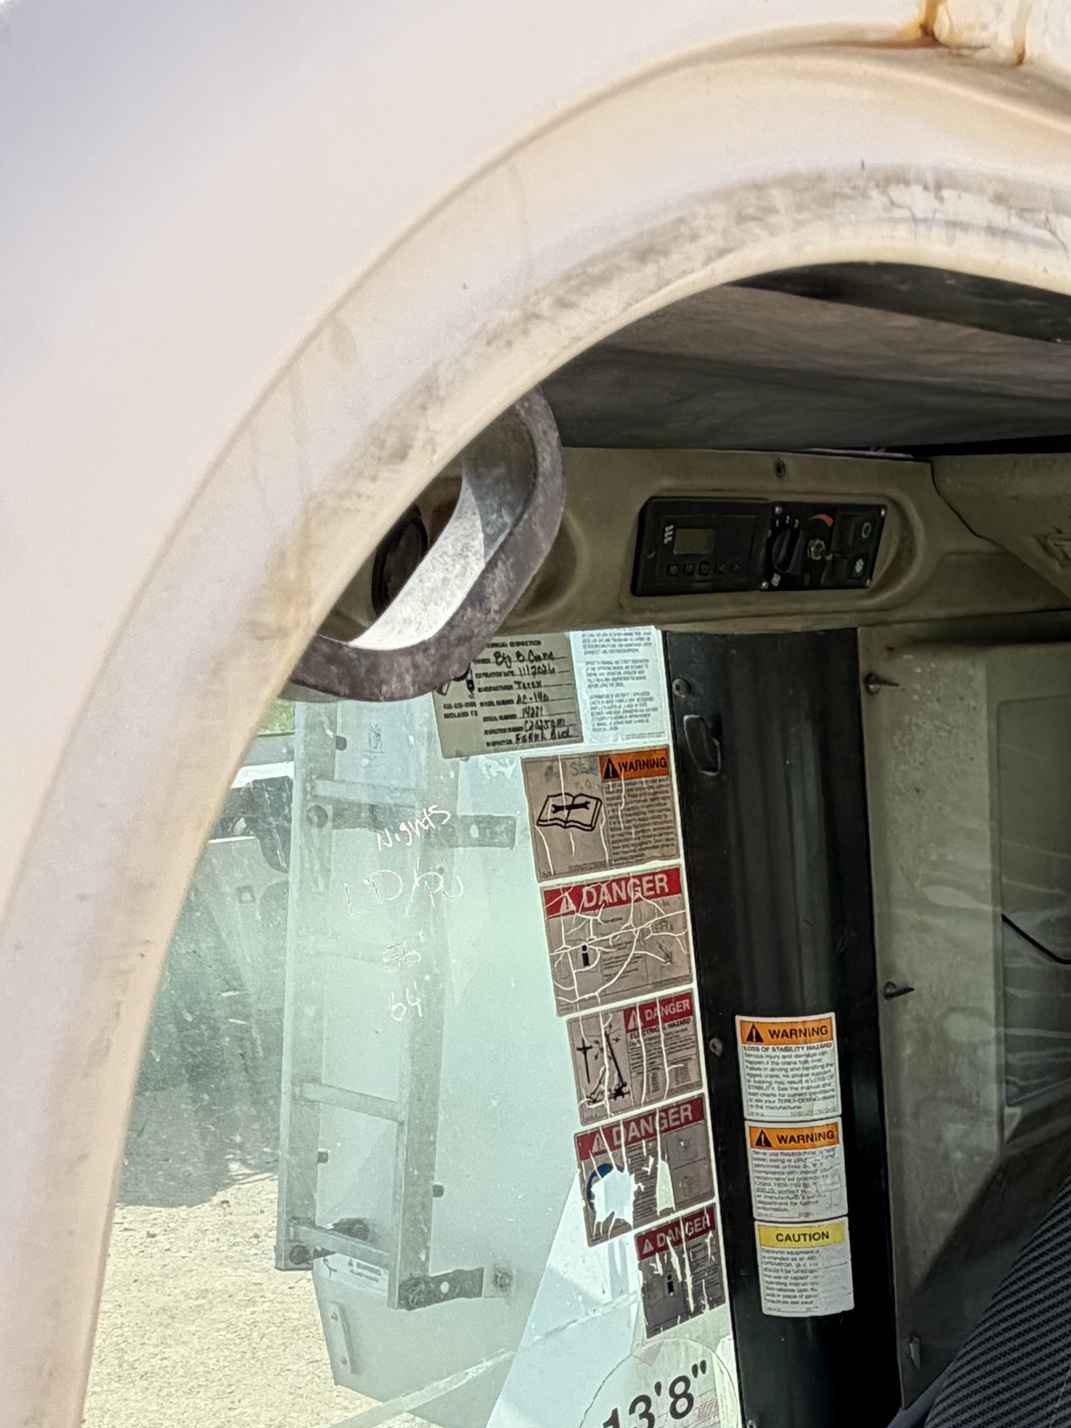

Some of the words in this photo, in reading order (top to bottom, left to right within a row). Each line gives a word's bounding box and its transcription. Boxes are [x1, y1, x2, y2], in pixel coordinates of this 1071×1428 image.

[617, 757, 668, 773] WARNING
[582, 873, 670, 909] DANGER
[643, 998, 692, 1020] DANGER
[768, 1025, 829, 1041] WARNING
[611, 1103, 693, 1147] DANGER
[776, 1130, 835, 1145] WARNING
[656, 1214, 711, 1248] DANGER
[775, 1231, 830, 1243] CAUTION
